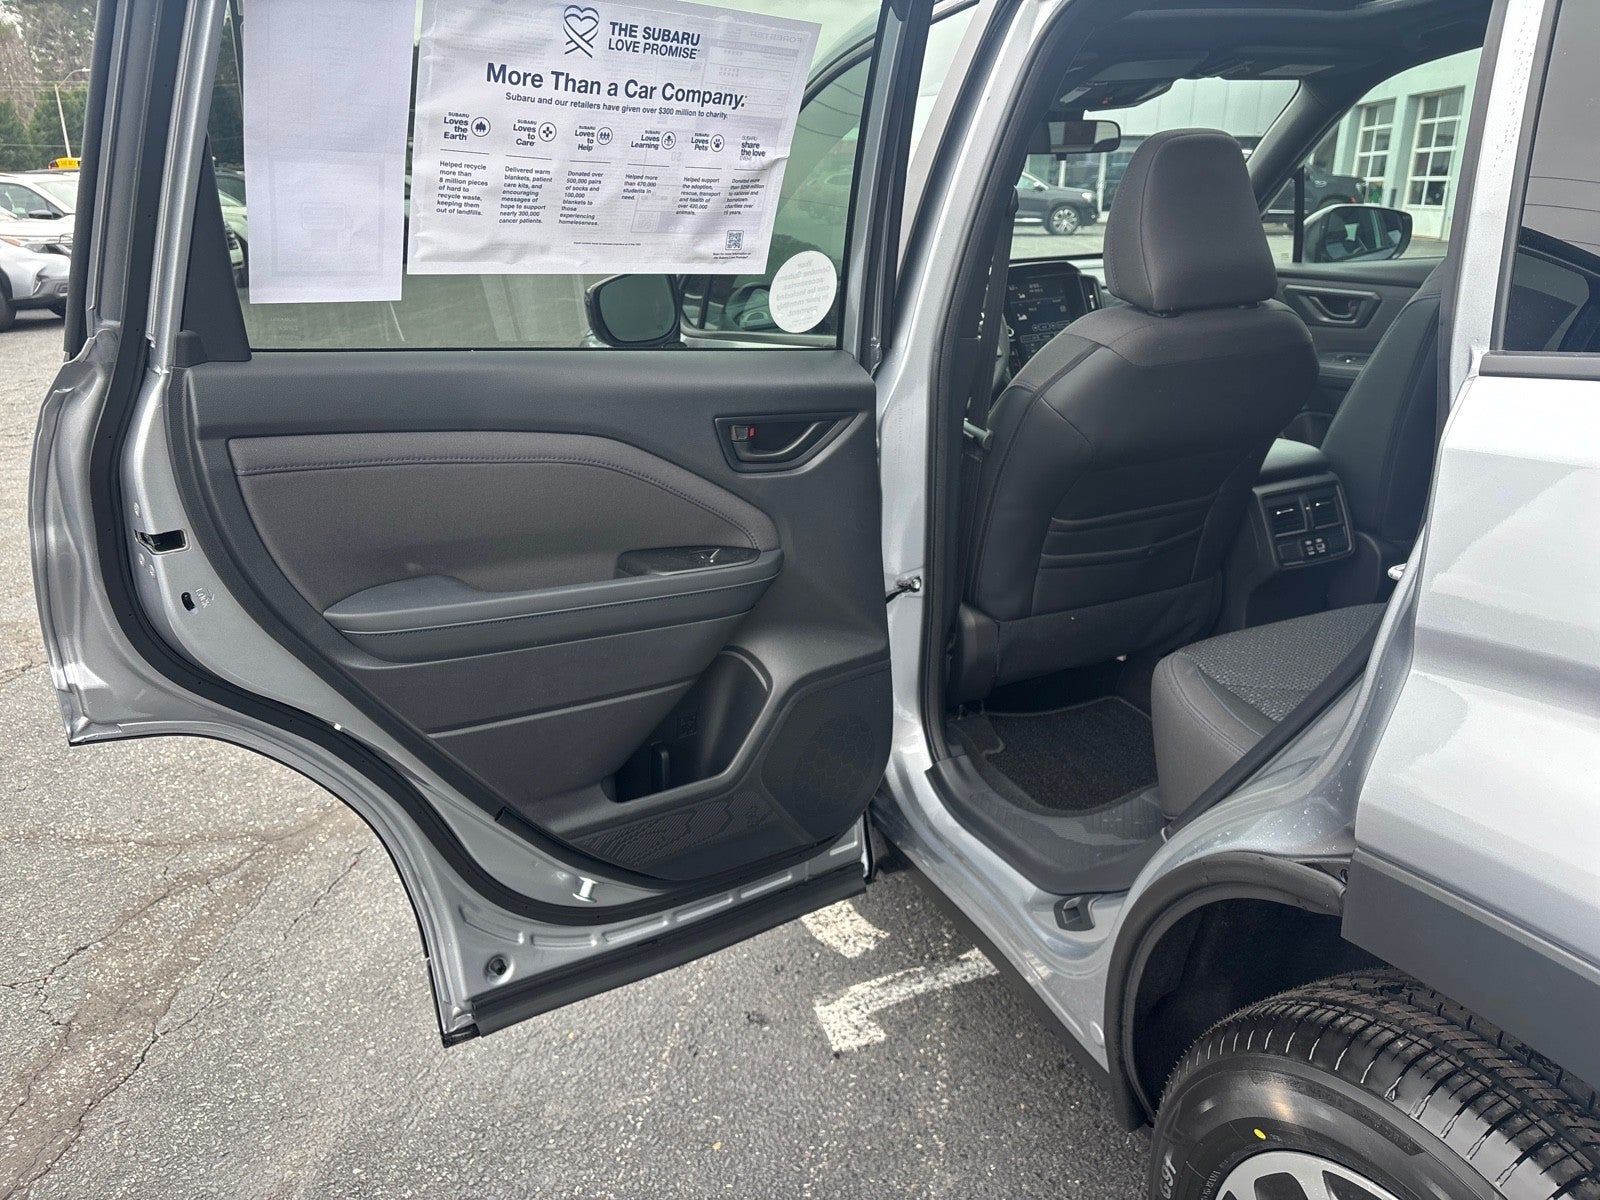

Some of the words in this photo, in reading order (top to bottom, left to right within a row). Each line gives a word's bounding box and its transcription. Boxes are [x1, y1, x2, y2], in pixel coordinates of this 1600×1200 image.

[609, 21, 639, 39] THE
[642, 25, 701, 46] SUBARU
[608, 38, 640, 53] LOVE
[486, 62, 544, 88] More
[550, 70, 601, 95] Than
[607, 82, 618, 97] a
[624, 78, 657, 100] Car
[505, 92, 536, 103] Subaru
[538, 96, 552, 104] and
[570, 100, 600, 110] retailers
[602, 103, 620, 111] have
[622, 104, 641, 114] given
[658, 106, 674, 116] $300
[675, 108, 697, 117] million
[705, 110, 728, 120] charity.
[444, 116, 469, 126] Loves
[454, 125, 468, 134] the
[513, 124, 536, 132] Loves
[444, 132, 468, 140] Earth
[528, 132, 536, 140] to
[574, 130, 595, 138] Loves
[516, 138, 535, 146] Care
[630, 141, 659, 150] Learning
[578, 144, 593, 152] Help
[440, 160, 462, 168] Helped
[504, 166, 534, 174] Delivered
[504, 174, 531, 182] blankets,
[436, 200, 462, 208] keeping
